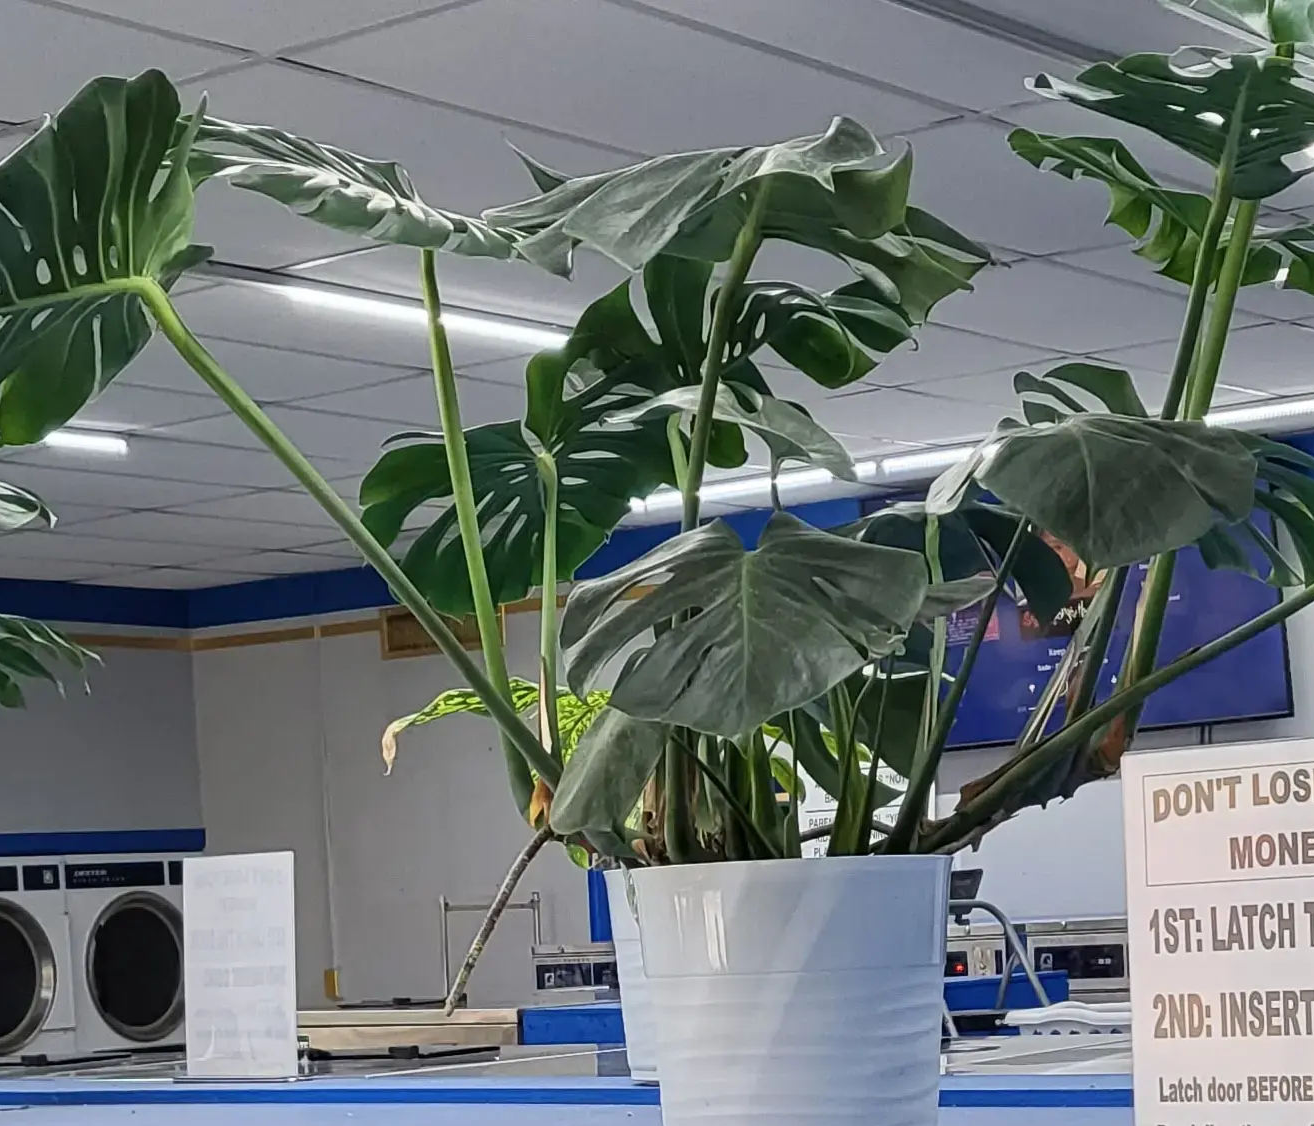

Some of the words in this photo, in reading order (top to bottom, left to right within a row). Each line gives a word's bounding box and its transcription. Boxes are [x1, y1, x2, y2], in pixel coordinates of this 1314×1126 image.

[1152, 776, 1241, 823] DON'T
[1149, 907, 1203, 954] 1ST:
[1210, 902, 1296, 951] LATCH
[1152, 993, 1212, 1038] 2ND:
[1159, 1076, 1202, 1103] Latch
[1207, 1076, 1243, 1102] door
[1247, 1075, 1313, 1102] BEFORE
